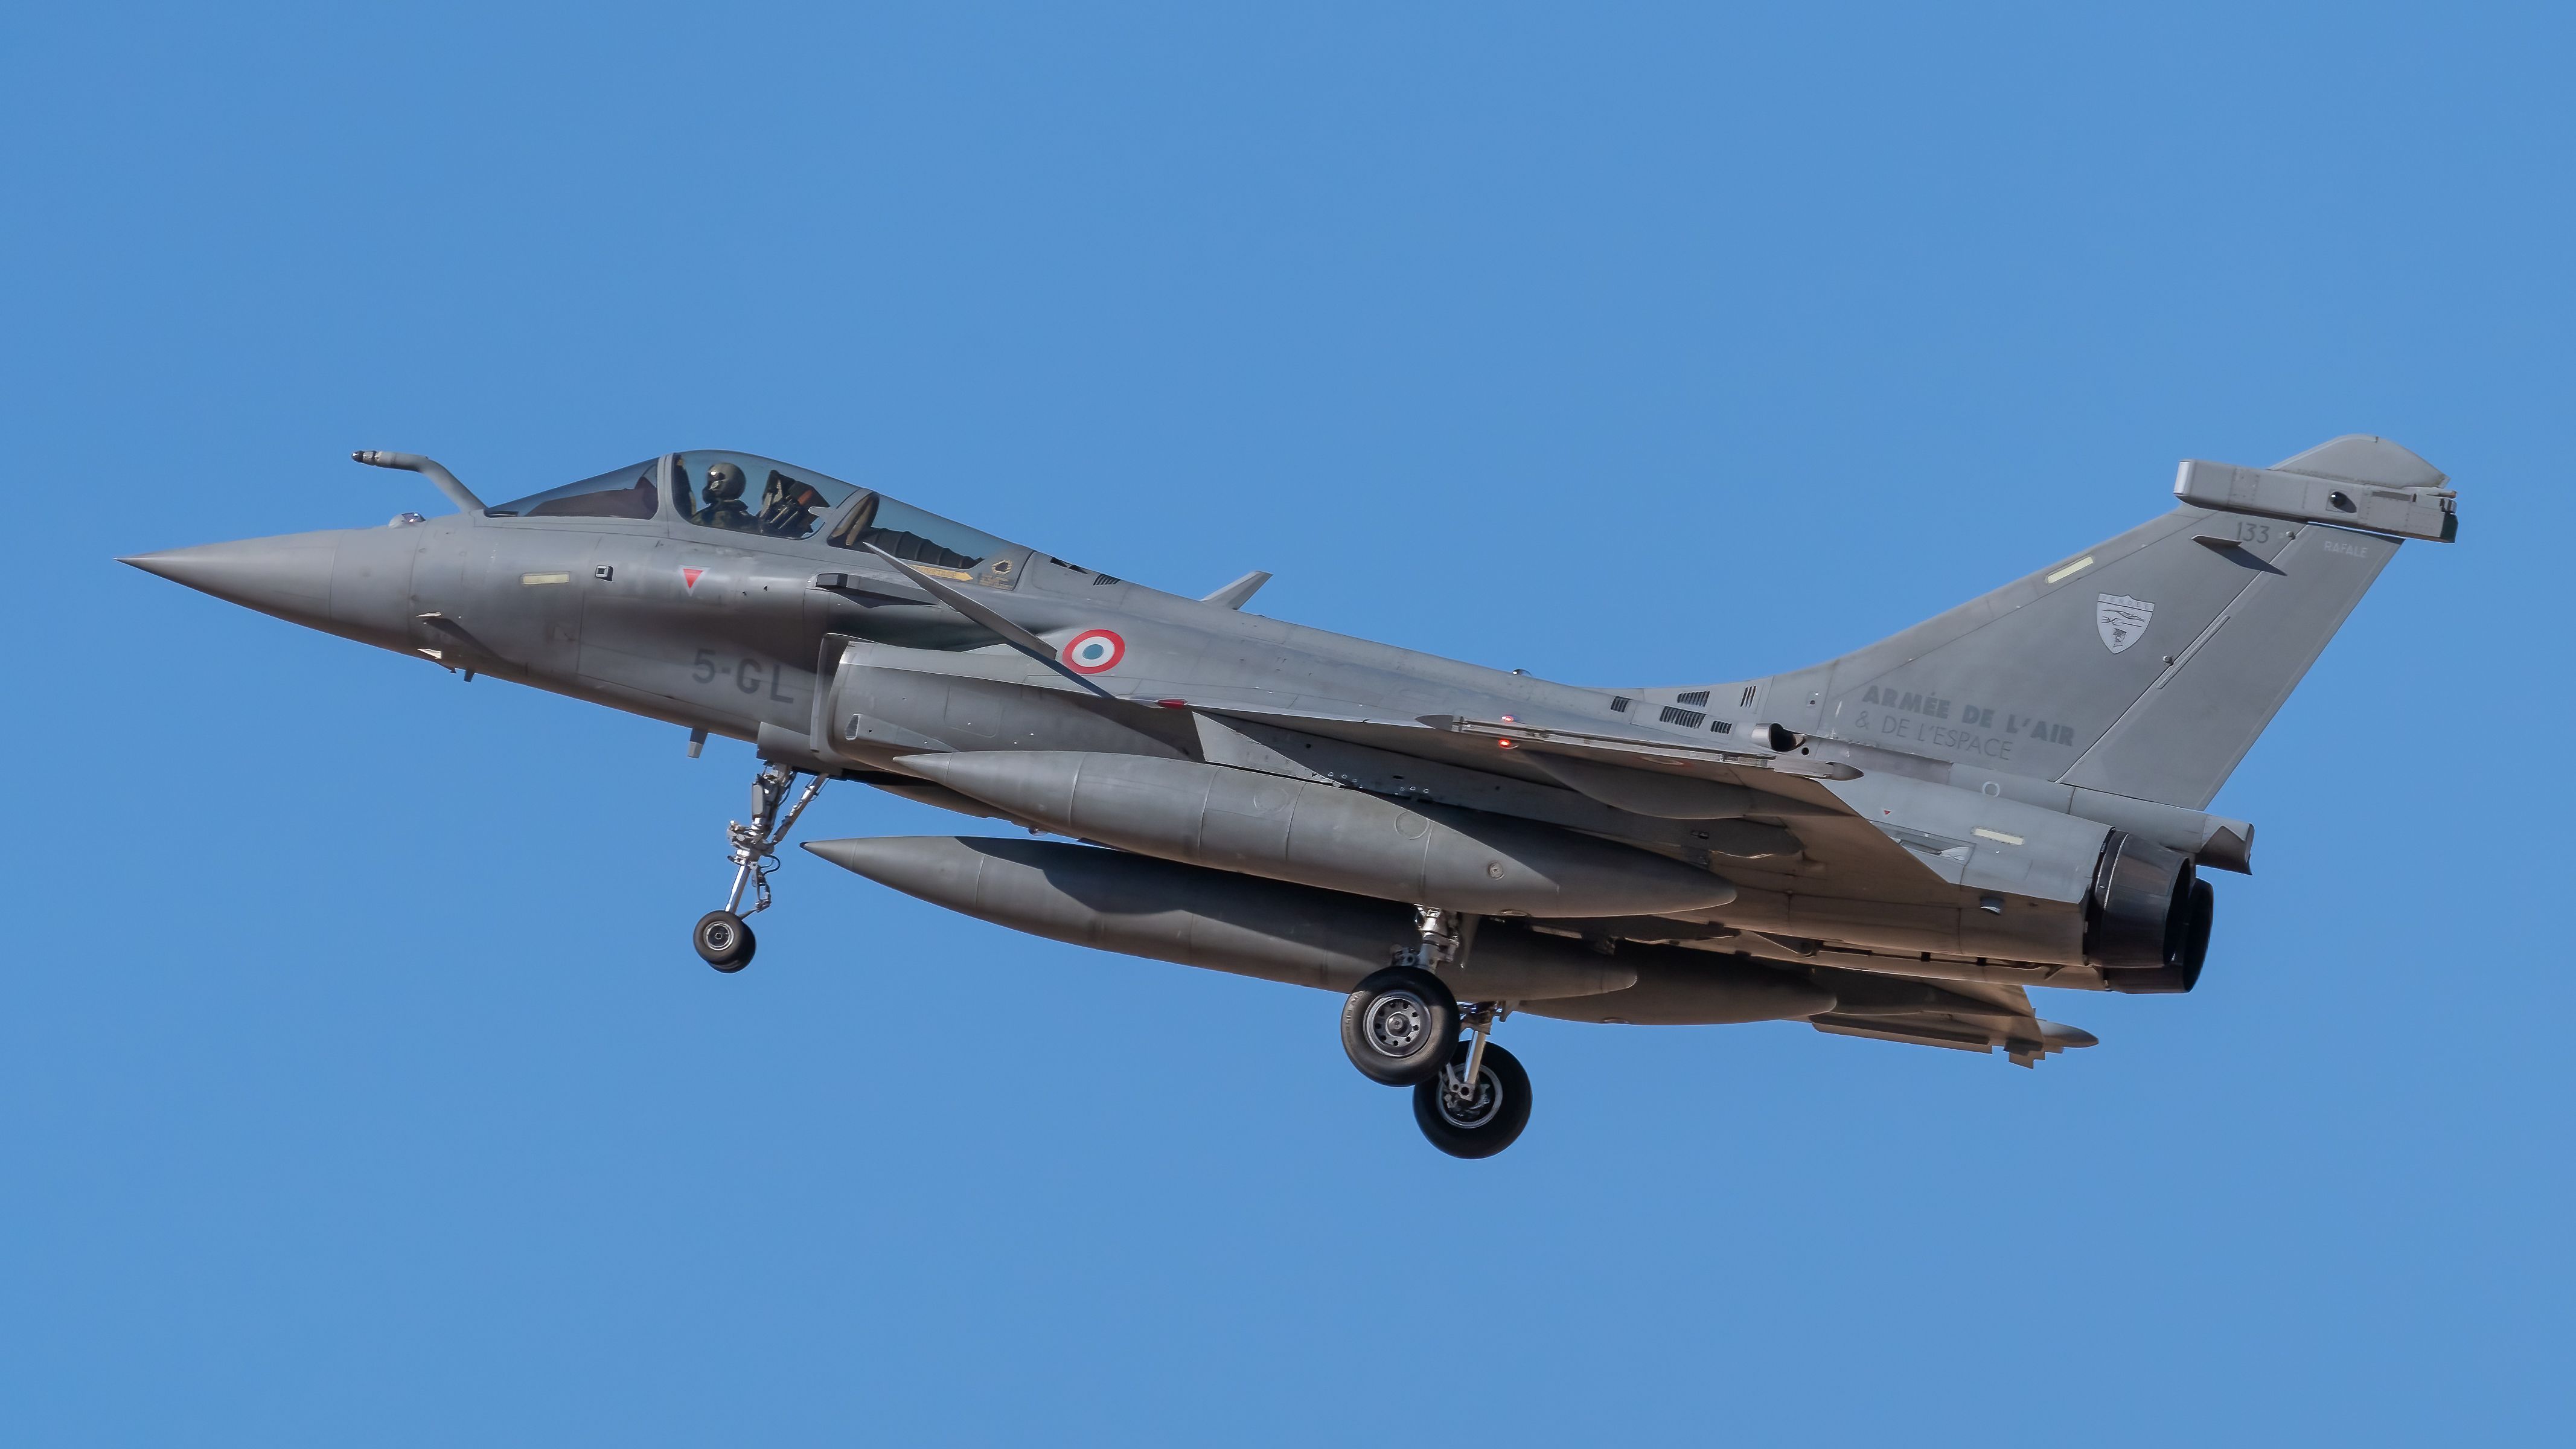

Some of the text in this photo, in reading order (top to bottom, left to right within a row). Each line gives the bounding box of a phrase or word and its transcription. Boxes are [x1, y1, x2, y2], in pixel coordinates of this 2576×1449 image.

[2236, 522, 2270, 543] 133
[2324, 540, 2367, 558] RAFALE
[692, 648, 794, 704] 5-GL
[1855, 710, 2013, 761] & DE L'ESPACE
[1862, 685, 2075, 747] ARMÉE DE L'AIR
